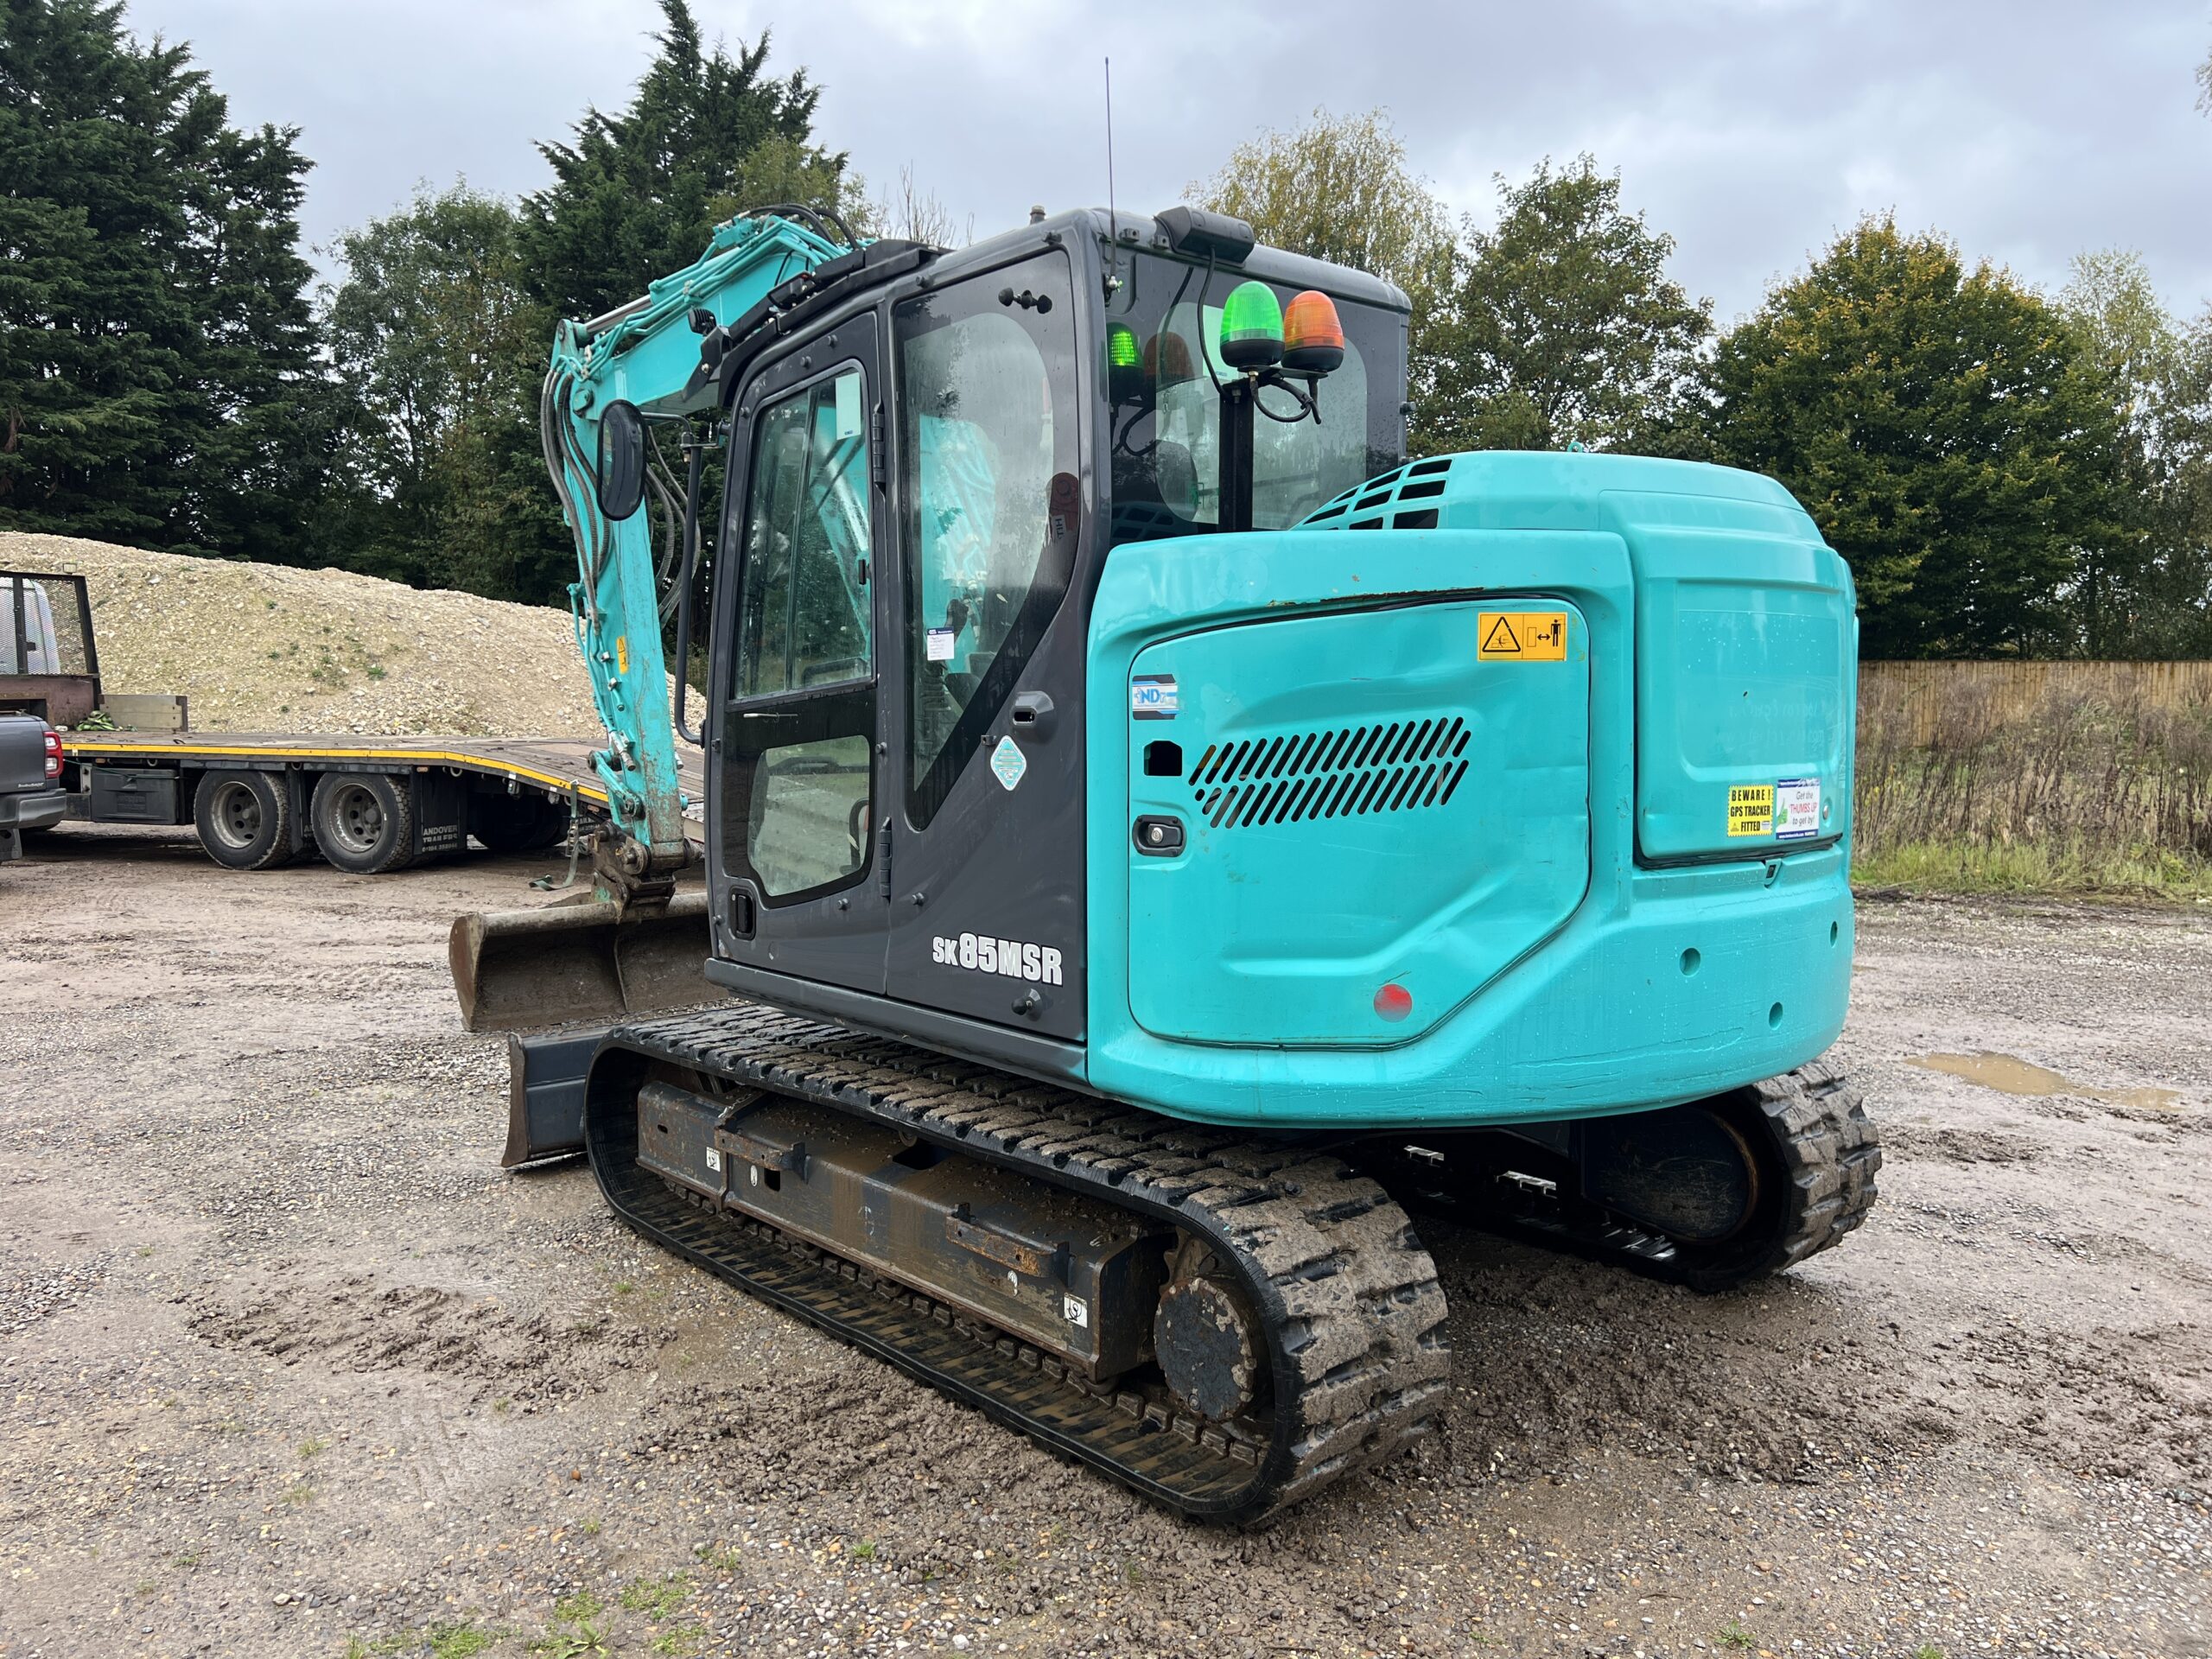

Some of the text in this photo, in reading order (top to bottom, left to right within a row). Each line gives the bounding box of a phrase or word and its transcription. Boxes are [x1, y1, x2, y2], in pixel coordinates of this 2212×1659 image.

[1732, 789, 1764, 801] BEWARE
[1796, 791, 1806, 800] Get
[1731, 804, 1770, 817] GPS TRACKER
[1741, 821, 1760, 832] FITTED
[1799, 817, 1808, 827] get
[423, 824, 458, 836] ANDOVER
[932, 932, 1064, 986] SK85MSR
